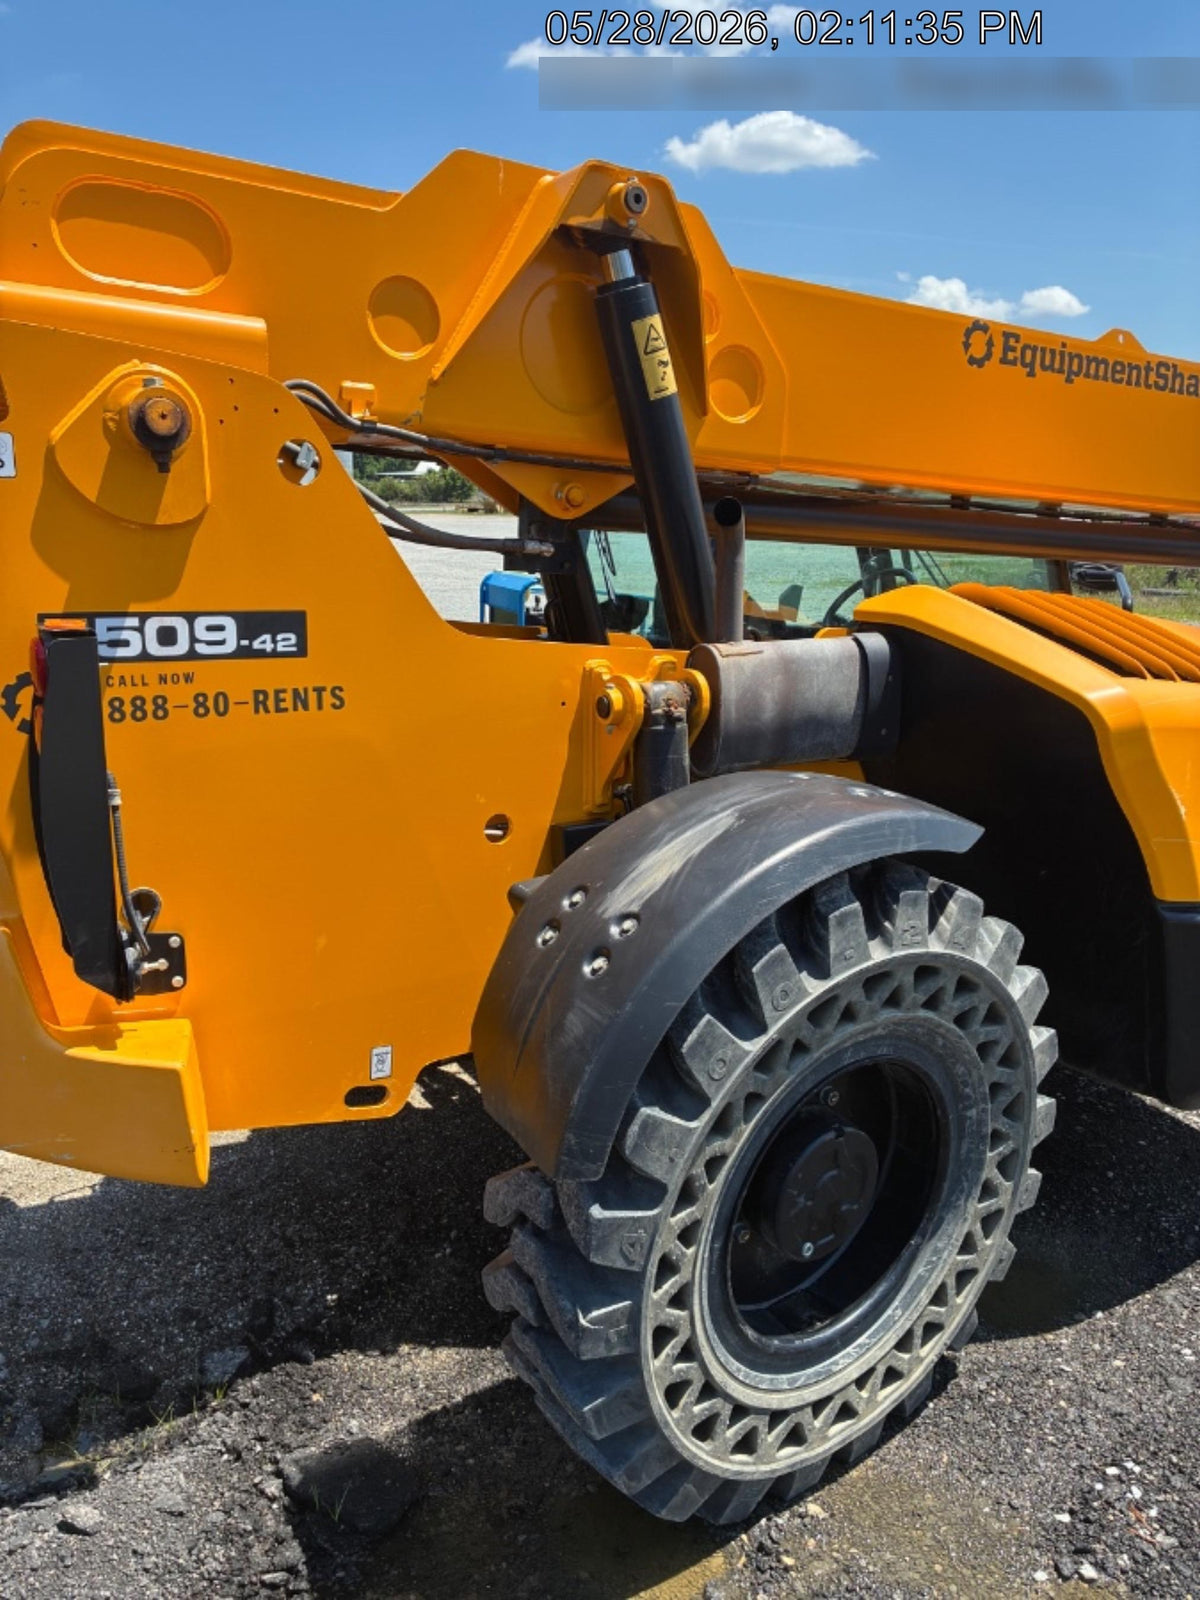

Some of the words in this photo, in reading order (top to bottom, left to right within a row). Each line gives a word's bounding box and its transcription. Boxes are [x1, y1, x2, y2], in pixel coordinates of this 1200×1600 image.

[96, 616, 298, 657] 509-42
[105, 674, 149, 688] CALL
[158, 671, 196, 686] NOW
[107, 685, 346, 723] 888-80-RENTS
